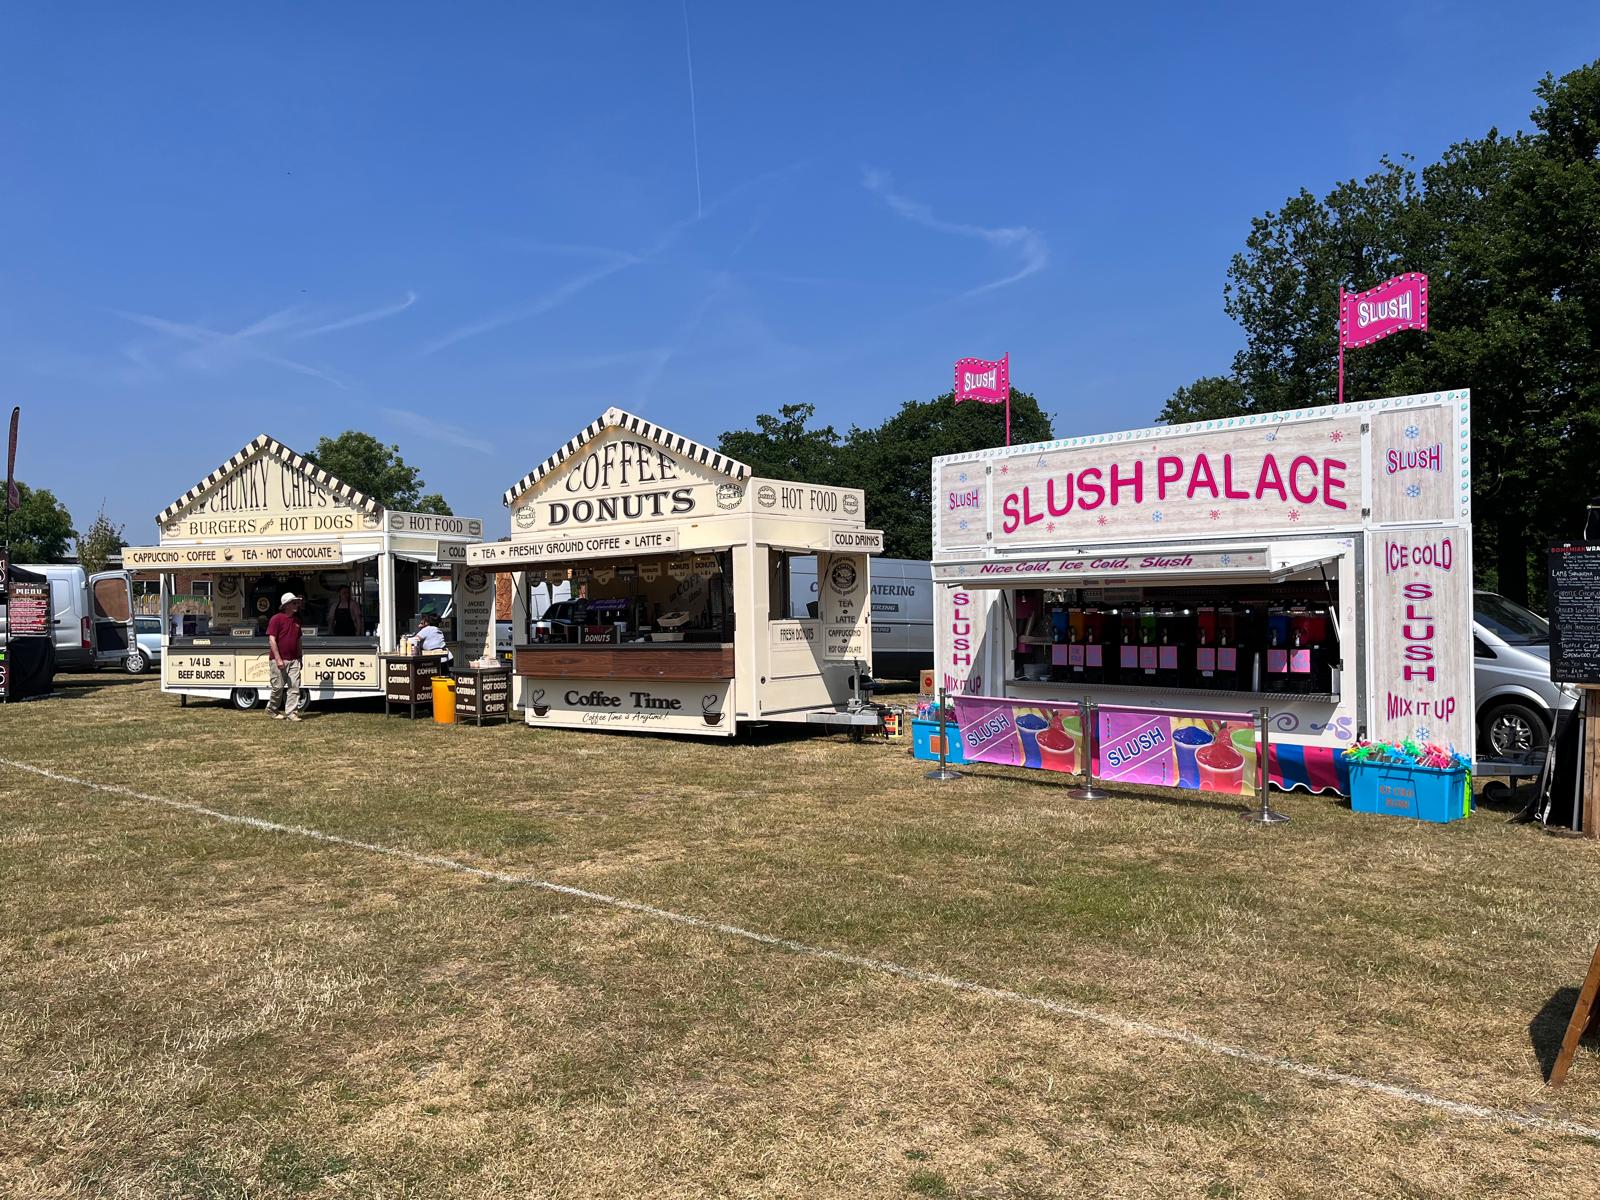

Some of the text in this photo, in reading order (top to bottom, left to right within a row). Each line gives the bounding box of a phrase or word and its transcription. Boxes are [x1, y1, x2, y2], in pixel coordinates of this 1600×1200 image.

[1357, 289, 1412, 328] SLUSH
[964, 368, 996, 392] SLUSH
[565, 441, 680, 493] COFFEE
[1386, 442, 1442, 475] SLUSH
[210, 457, 327, 512] CHUNKY CHIPS
[1002, 453, 1347, 533] SLUSH PALACE
[548, 488, 695, 525] DONUTS
[781, 487, 803, 509] HOT
[810, 490, 837, 511] FOOD
[949, 489, 979, 510] SLUSH
[189, 519, 256, 535] BURGERS
[280, 516, 307, 531] HOT
[314, 514, 353, 529] DOGS
[410, 516, 432, 529] HOT
[434, 518, 463, 532] FOOD
[481, 534, 662, 558] TEA FRESHLY GROUND COFFEE LATTE
[835, 534, 880, 546] COLD DRINKS
[133, 547, 332, 563] CAPPUCCINO COFFEE TEA HOT CHOCOLATE
[448, 547, 466, 557] COLD
[1385, 538, 1452, 574] ICE COLD
[981, 554, 1193, 574] Nice Cold, Ice Cold, Slush
[871, 585, 915, 596] ATERING
[838, 600, 854, 608] TEA
[585, 634, 610, 642] DONUTS
[780, 629, 795, 641] FRESH
[828, 629, 861, 637] CAPPUCCINO
[953, 593, 970, 666] SLUSH
[1402, 582, 1436, 682] SLUSH
[190, 657, 211, 667] 1/4 LB
[325, 657, 354, 667] GIANT
[178, 670, 225, 679] BEEF BURGER
[315, 671, 366, 681] HOT DOGS
[944, 673, 981, 694] MIX IT UP
[482, 681, 507, 690] HOT DOGS
[483, 692, 507, 702] CHEESY
[564, 690, 682, 710] Coffee Time
[1387, 692, 1455, 722] MIX IT UP
[485, 703, 505, 712] CHIPS
[582, 712, 606, 725] Coffee
[607, 712, 623, 722] Time
[966, 714, 1010, 748] SLUSH
[1106, 726, 1165, 768] SLUSH
